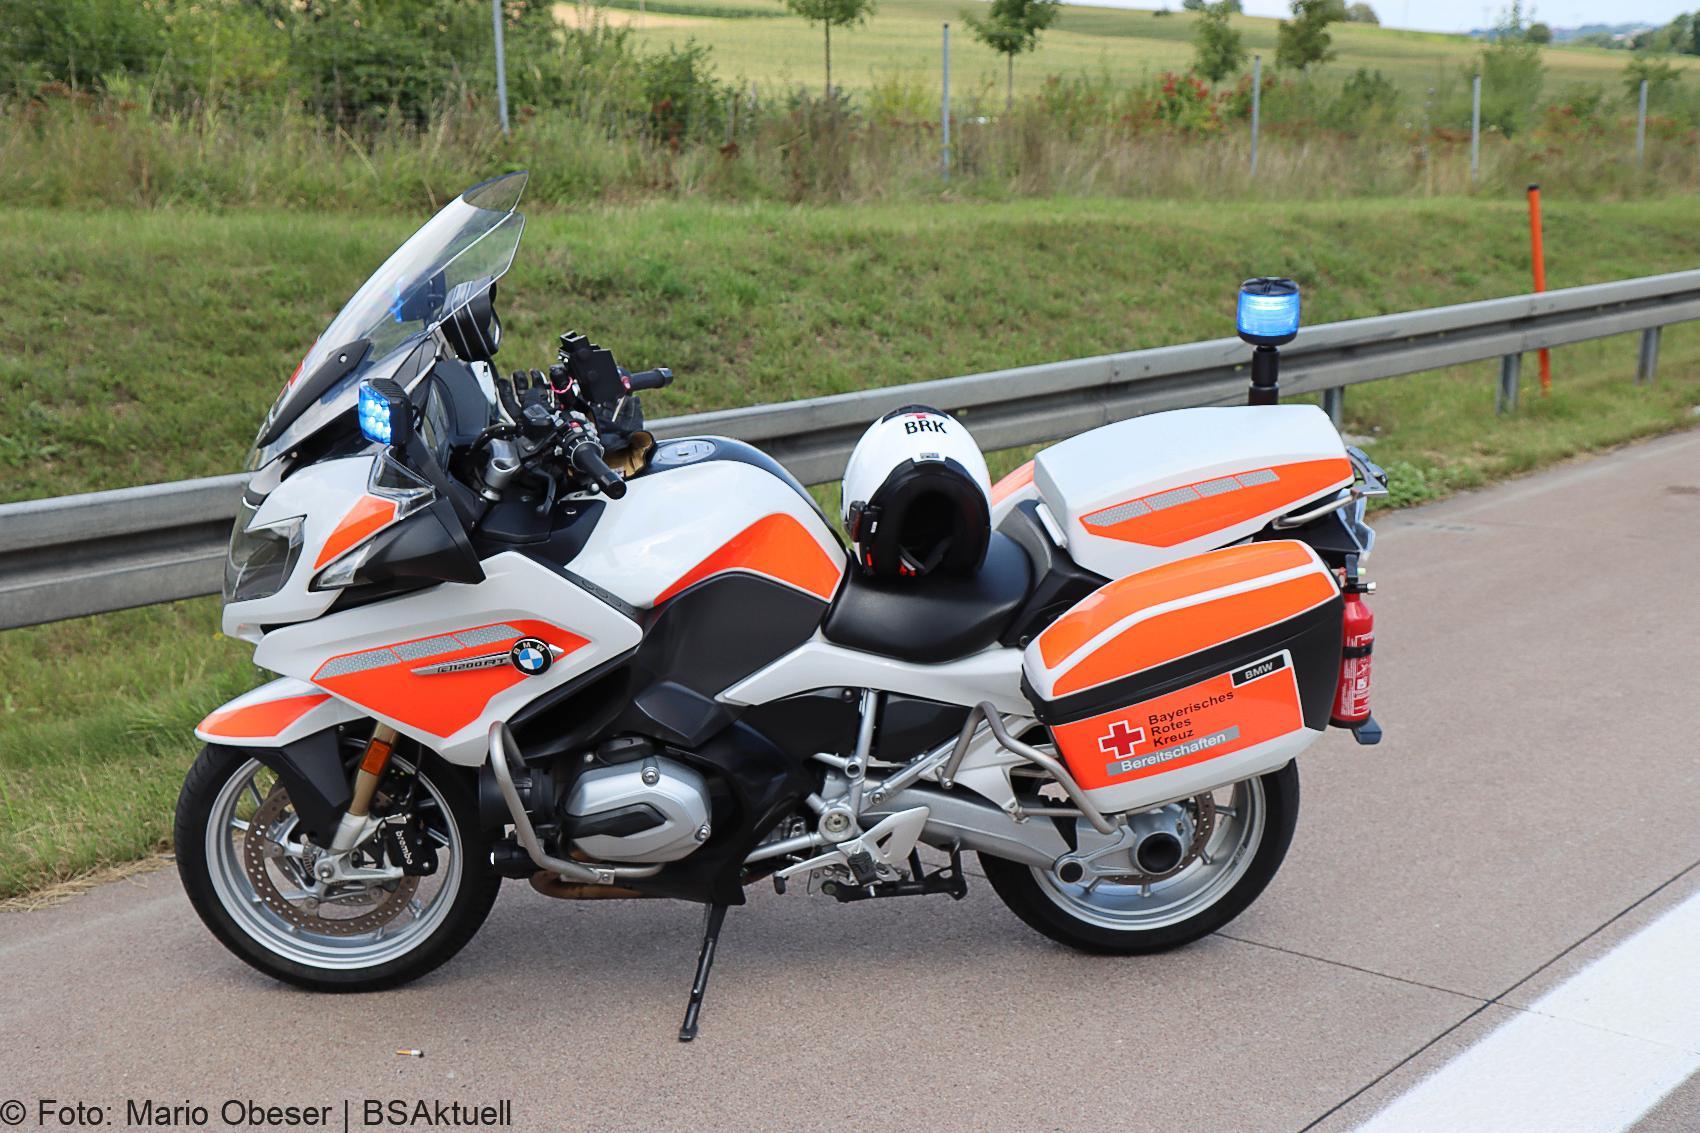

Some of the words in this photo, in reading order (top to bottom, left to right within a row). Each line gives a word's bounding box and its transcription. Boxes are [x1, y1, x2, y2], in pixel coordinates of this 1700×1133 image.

[904, 420, 947, 435] BRK
[513, 641, 546, 655] BMW
[1244, 661, 1274, 680] BMW
[1148, 691, 1234, 725] Bayerisches
[1150, 718, 1192, 736] Rotes
[1152, 729, 1195, 748] Kreuz
[1120, 733, 1226, 772] Bereitschaften
[395, 829, 413, 865] brembo
